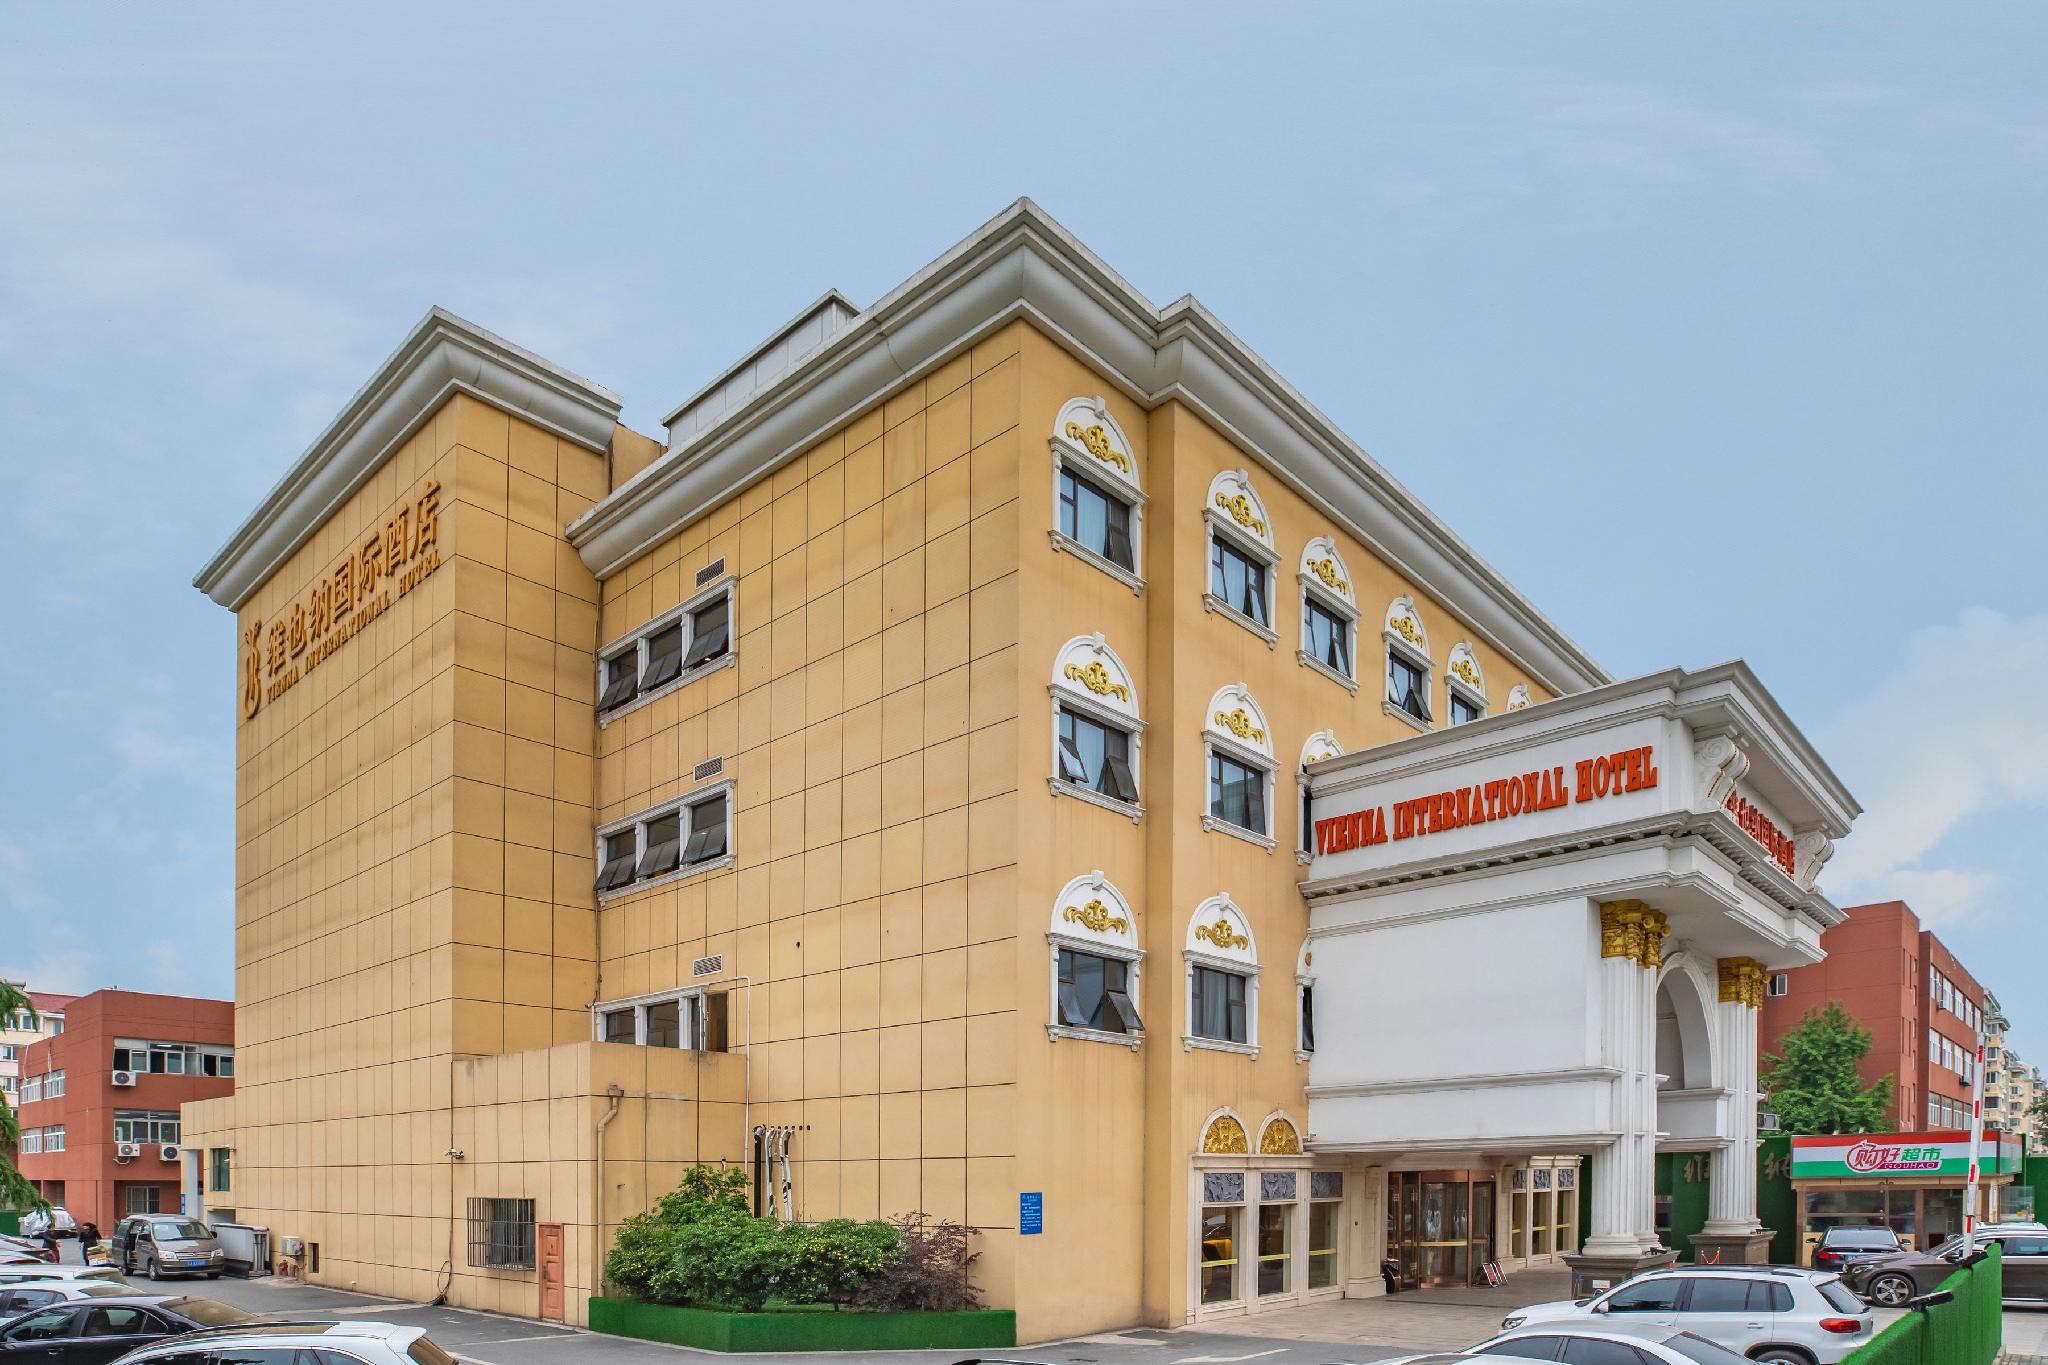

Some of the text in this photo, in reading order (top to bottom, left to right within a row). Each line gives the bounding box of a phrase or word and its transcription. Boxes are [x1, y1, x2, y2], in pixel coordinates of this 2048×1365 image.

[266, 480, 441, 678] 维也纳国际酒店
[304, 590, 391, 676] INTERNATIONAL
[399, 548, 441, 600] HOTEL
[1314, 745, 1658, 856] VIENNA INTERNATIONAL HOTEL
